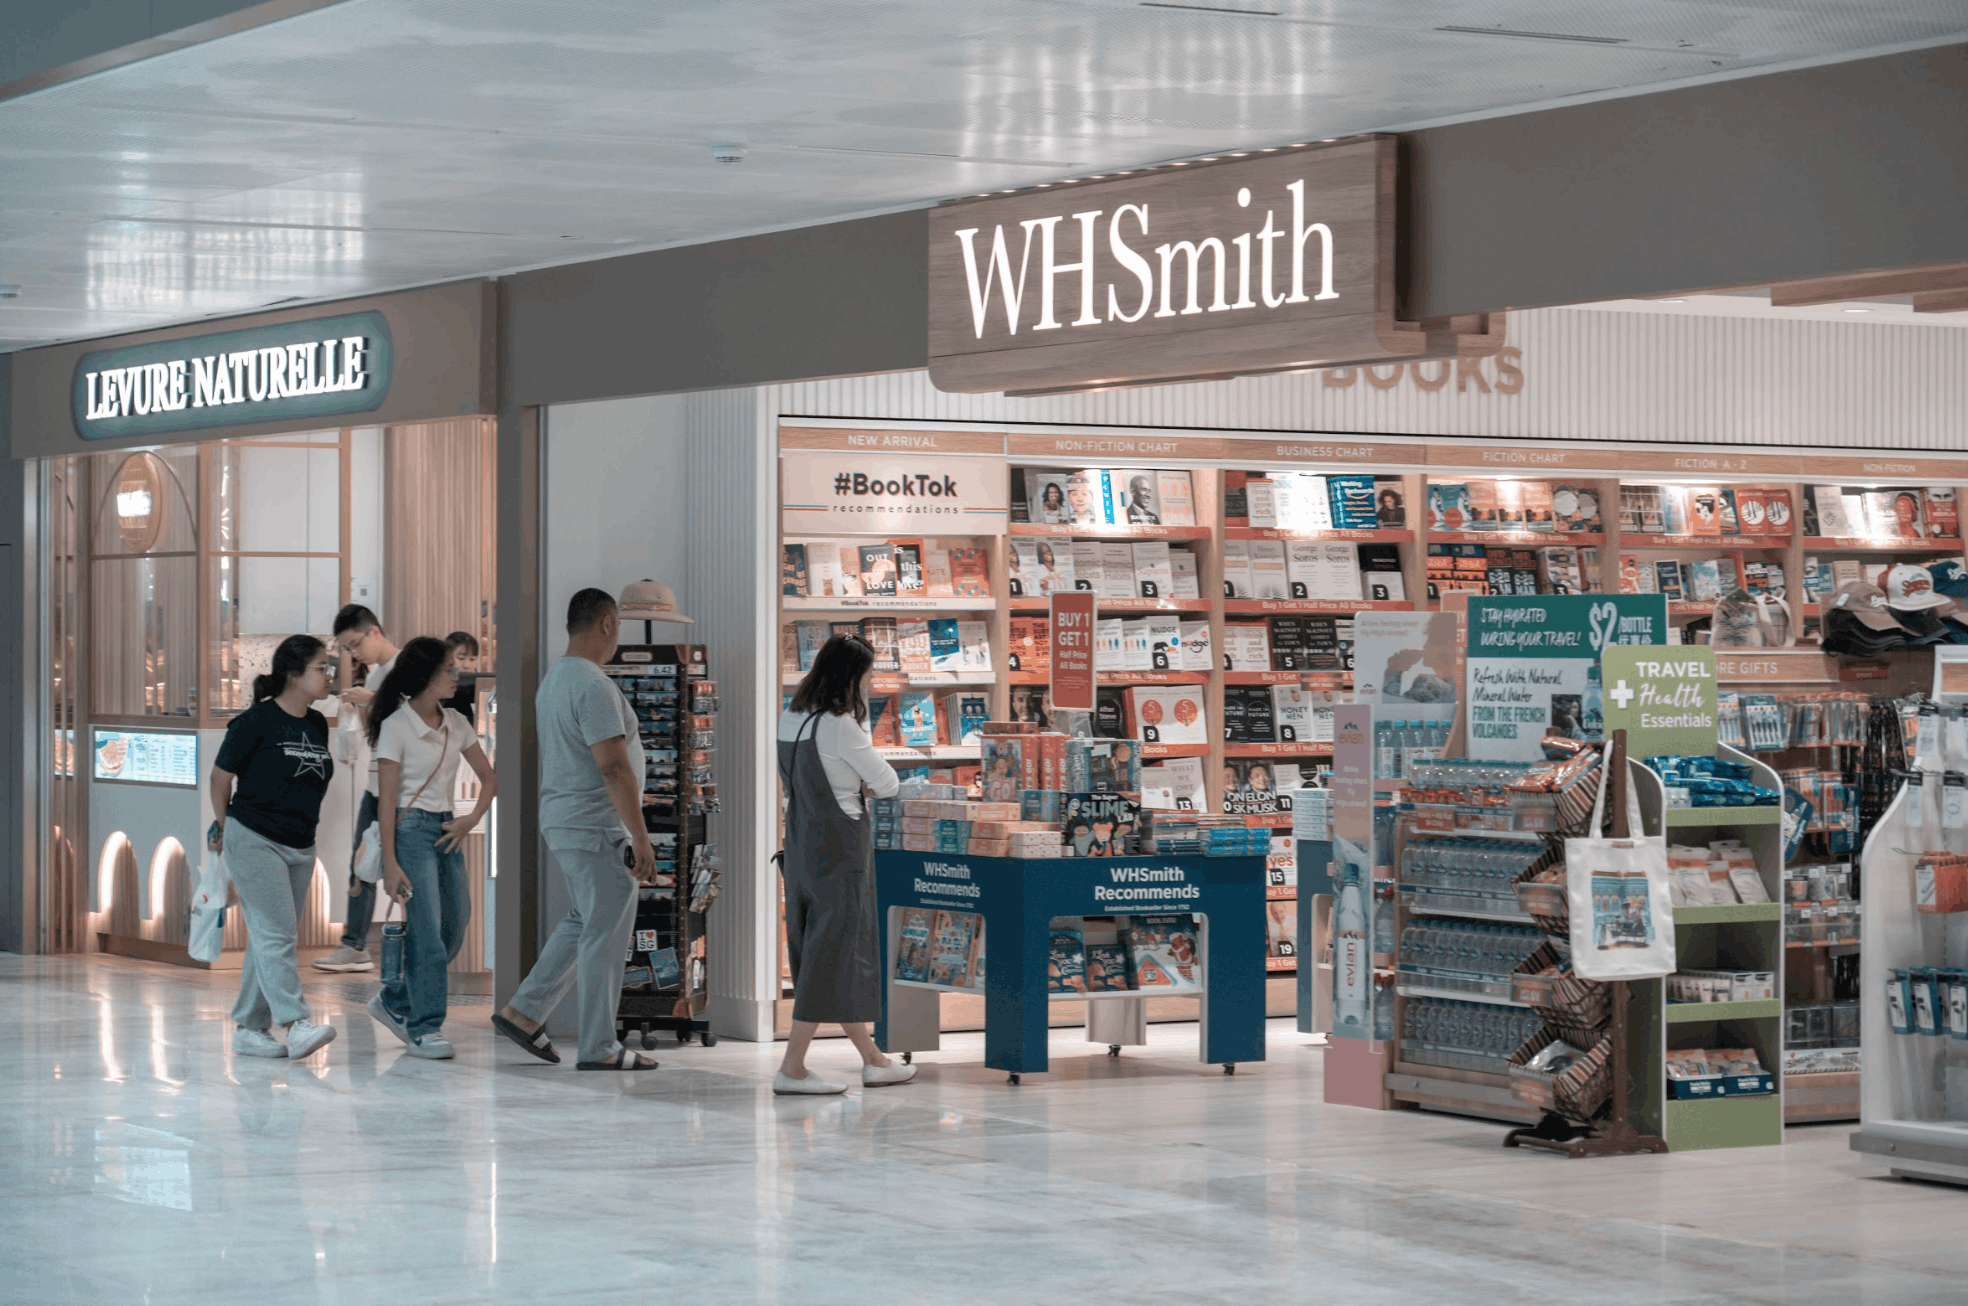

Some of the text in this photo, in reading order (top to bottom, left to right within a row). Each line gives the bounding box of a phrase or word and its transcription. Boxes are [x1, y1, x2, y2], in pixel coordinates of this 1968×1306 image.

[955, 178, 1341, 339] WHSmith
[85, 336, 366, 420] LEVURE NATURELLE
[847, 435, 938, 447] NEW ARRIVAL
[1055, 440, 1178, 453] NON-FICTION CHART
[1276, 446, 1374, 458] BUSINESS CHART
[1483, 451, 1564, 463] FICTION CHART
[1674, 458, 1718, 469] FICTION
[1723, 459, 1732, 469] A
[1740, 460, 1747, 470] Z
[1863, 464, 1917, 473] NON-FICTION
[833, 472, 959, 498] #BookTok
[832, 504, 959, 515] recommendations
[1263, 530, 1278, 539] Buy
[1351, 532, 1374, 540] Books
[1463, 532, 1478, 541] Buy
[1292, 545, 1318, 553] George
[866, 553, 889, 562] OUT
[1293, 554, 1319, 563] Soros
[1326, 554, 1351, 563] Soros
[900, 561, 923, 571] this
[866, 581, 895, 590] LOVE
[1010, 581, 1018, 593] 1
[1145, 584, 1155, 595] 3
[1295, 585, 1305, 596] 2
[1376, 587, 1386, 598] 3
[872, 600, 938, 608] recommendations
[1262, 601, 1278, 611] Buy
[1284, 602, 1298, 610] Get
[1303, 602, 1318, 610] Half
[1319, 602, 1338, 610] Price
[1350, 602, 1374, 611] Books
[1057, 611, 1091, 628] BUY 1
[1480, 607, 1503, 629] STAY
[1150, 626, 1178, 634] NUDGE
[1588, 601, 1618, 652] $2
[1057, 630, 1090, 647] GET 1
[1517, 631, 1544, 652] YOUR
[1543, 631, 1582, 648] TRAVEL!
[1058, 650, 1088, 660] Half Price
[1059, 661, 1088, 671] All Books
[1156, 655, 1166, 667] 6
[1284, 656, 1293, 668] 5
[1346, 657, 1355, 668] 6
[653, 666, 672, 674] 6.42
[1635, 661, 1712, 678] TRAVEL
[1739, 661, 1779, 674] GIFTS
[1261, 672, 1297, 682] Buy Get
[1473, 666, 1563, 686] Refresh With Natural
[1472, 686, 1533, 703] Mineral Water
[1639, 682, 1706, 709] Health
[1280, 705, 1308, 714] MONEY
[1472, 705, 1546, 723] FROM THE FRENCH
[1640, 712, 1713, 729] Essentials
[1146, 729, 1156, 740] 9
[1225, 727, 1233, 739] 7
[1283, 728, 1293, 739] 8
[1472, 723, 1518, 739] VOLCANOES
[1143, 745, 1168, 754] Books
[1261, 743, 1317, 754] Buy Get Half
[1245, 791, 1276, 802] ELON
[1177, 800, 1191, 810] 13
[1246, 802, 1279, 814] MUSK
[1279, 798, 1292, 809] 11
[1080, 800, 1129, 819] SLIME
[1116, 813, 1135, 823] LAB
[1268, 855, 1294, 869] yes
[923, 861, 971, 880] WHSmith
[1110, 865, 1185, 883] WHSmith
[1270, 872, 1284, 882] 15
[913, 877, 981, 898] Recommends
[1094, 883, 1200, 901] Recommends
[639, 940, 655, 950] SG
[1279, 944, 1293, 955] 19
[1346, 941, 1357, 988] evian
